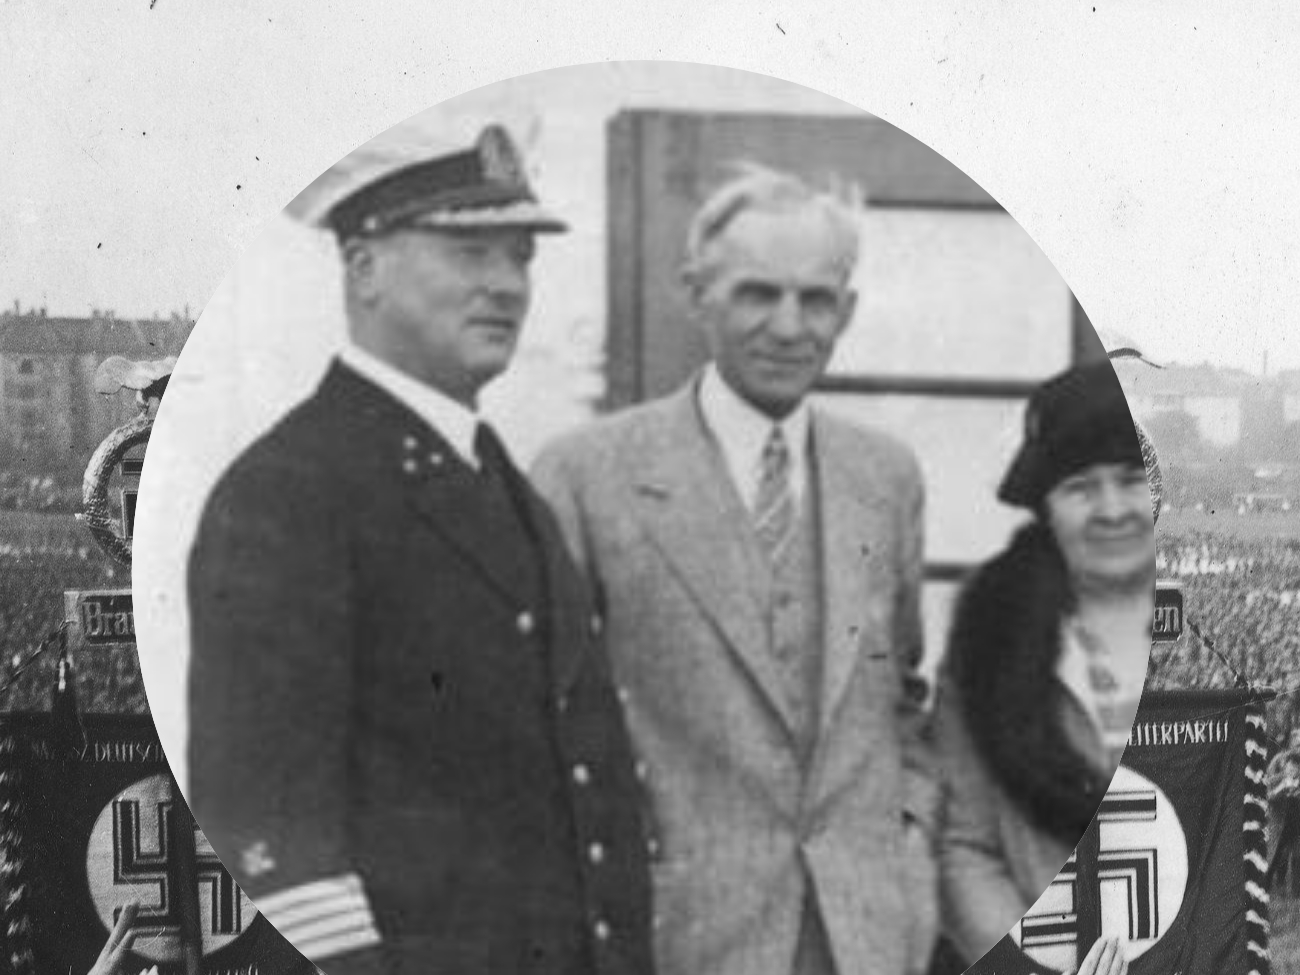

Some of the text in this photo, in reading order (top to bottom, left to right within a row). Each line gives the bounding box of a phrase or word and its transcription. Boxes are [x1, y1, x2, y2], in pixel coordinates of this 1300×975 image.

[82, 602, 136, 636] Bra
[1153, 606, 1181, 632] en
[1127, 720, 1229, 746] EITERPARTEI
